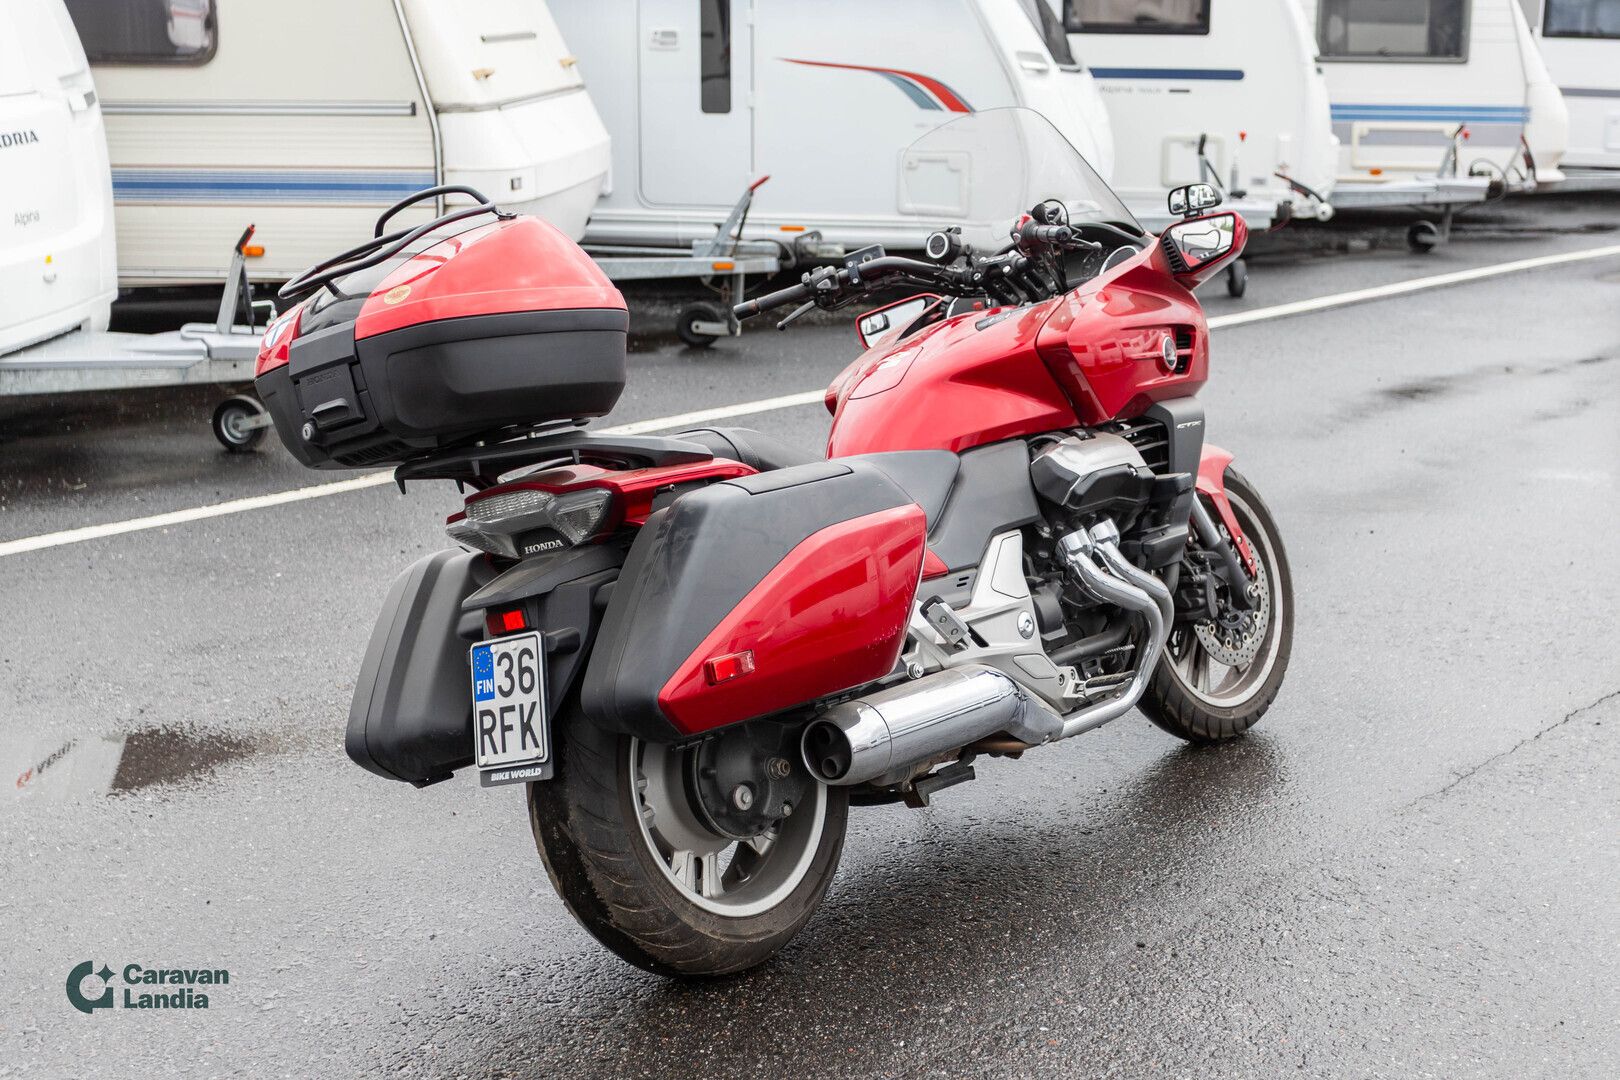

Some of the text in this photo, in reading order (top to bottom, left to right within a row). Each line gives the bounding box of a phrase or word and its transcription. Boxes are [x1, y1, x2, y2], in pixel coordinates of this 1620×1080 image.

[524, 539, 564, 555] HONDA
[496, 647, 536, 698] 36
[476, 678, 494, 695] FIN
[478, 701, 540, 757] RFK
[490, 767, 542, 782] BIKE WORLD
